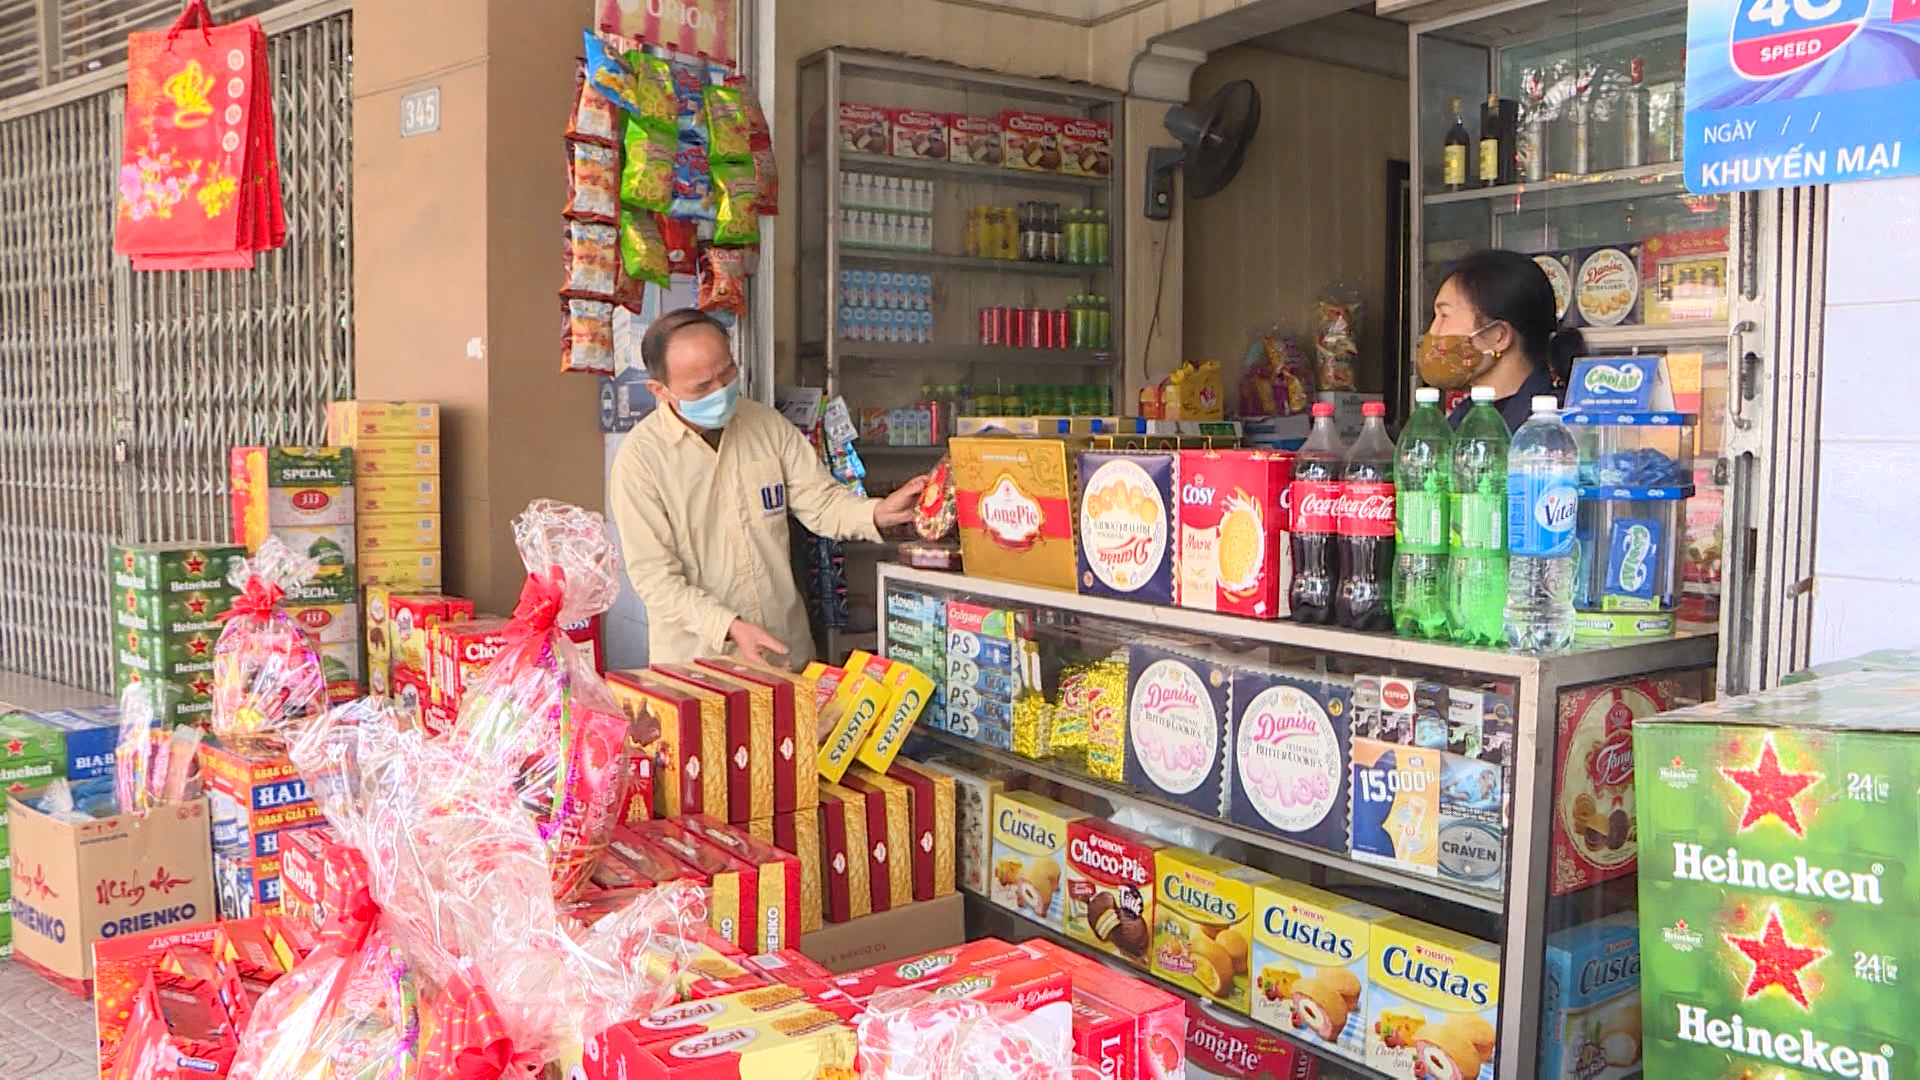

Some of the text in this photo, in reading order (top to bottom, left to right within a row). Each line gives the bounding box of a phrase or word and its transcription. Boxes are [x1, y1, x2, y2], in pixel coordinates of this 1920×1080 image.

[1760, 39, 1821, 62] SPEED
[406, 95, 435, 128] 345
[1704, 120, 1757, 143] NGÀY
[1702, 142, 1901, 187] KHUYẾN MẠI
[1584, 260, 1624, 284] Danisa
[282, 468, 336, 481] SPECIAL
[1182, 484, 1216, 505] COSY
[984, 503, 1038, 529] LongPie
[1099, 536, 1153, 571] Danisa
[949, 607, 983, 625] Colgate
[1143, 682, 1200, 713] Danisa
[829, 698, 875, 765] Custas
[875, 687, 921, 757] Custas
[1253, 709, 1319, 745] Danisa
[75, 754, 104, 769] BIA
[1847, 772, 1873, 791] 24
[1000, 808, 1057, 851] Custas
[1441, 841, 1498, 862] CRAVEN
[1673, 843, 1884, 904] Heineken
[1163, 874, 1237, 921] Custas
[101, 903, 197, 938] ORIENKO
[1263, 905, 1354, 960] Custas
[1424, 949, 1456, 965] ORION
[1578, 952, 1640, 994] Custa
[1853, 950, 1881, 971] 24
[1382, 945, 1489, 1006] Custas
[1185, 1015, 1260, 1071] LongPie
[1677, 1003, 1892, 1080] Heineken
